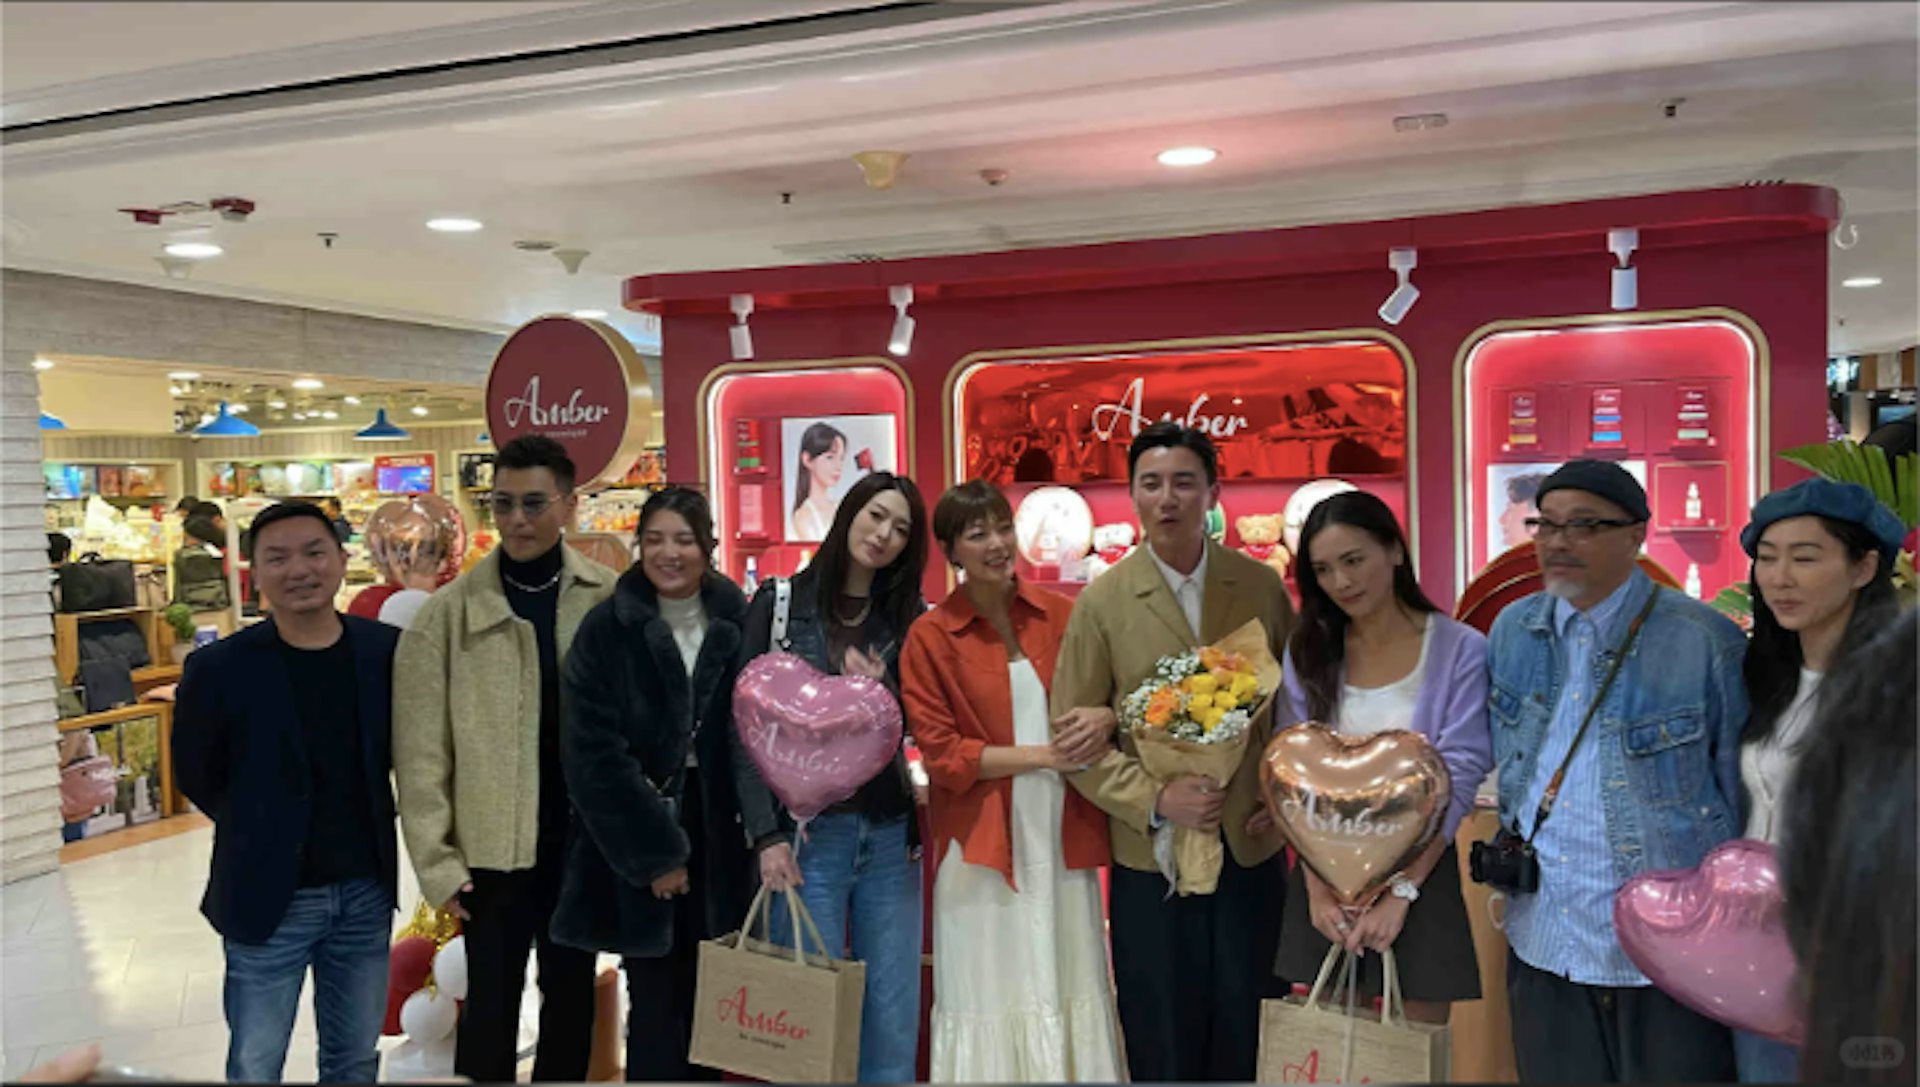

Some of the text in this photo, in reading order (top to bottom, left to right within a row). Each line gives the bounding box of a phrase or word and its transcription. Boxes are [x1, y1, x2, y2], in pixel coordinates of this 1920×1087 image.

[503, 375, 609, 428] Amber
[747, 722, 850, 776] Amber
[1281, 787, 1403, 836] Amber
[716, 984, 810, 1041] Amber
